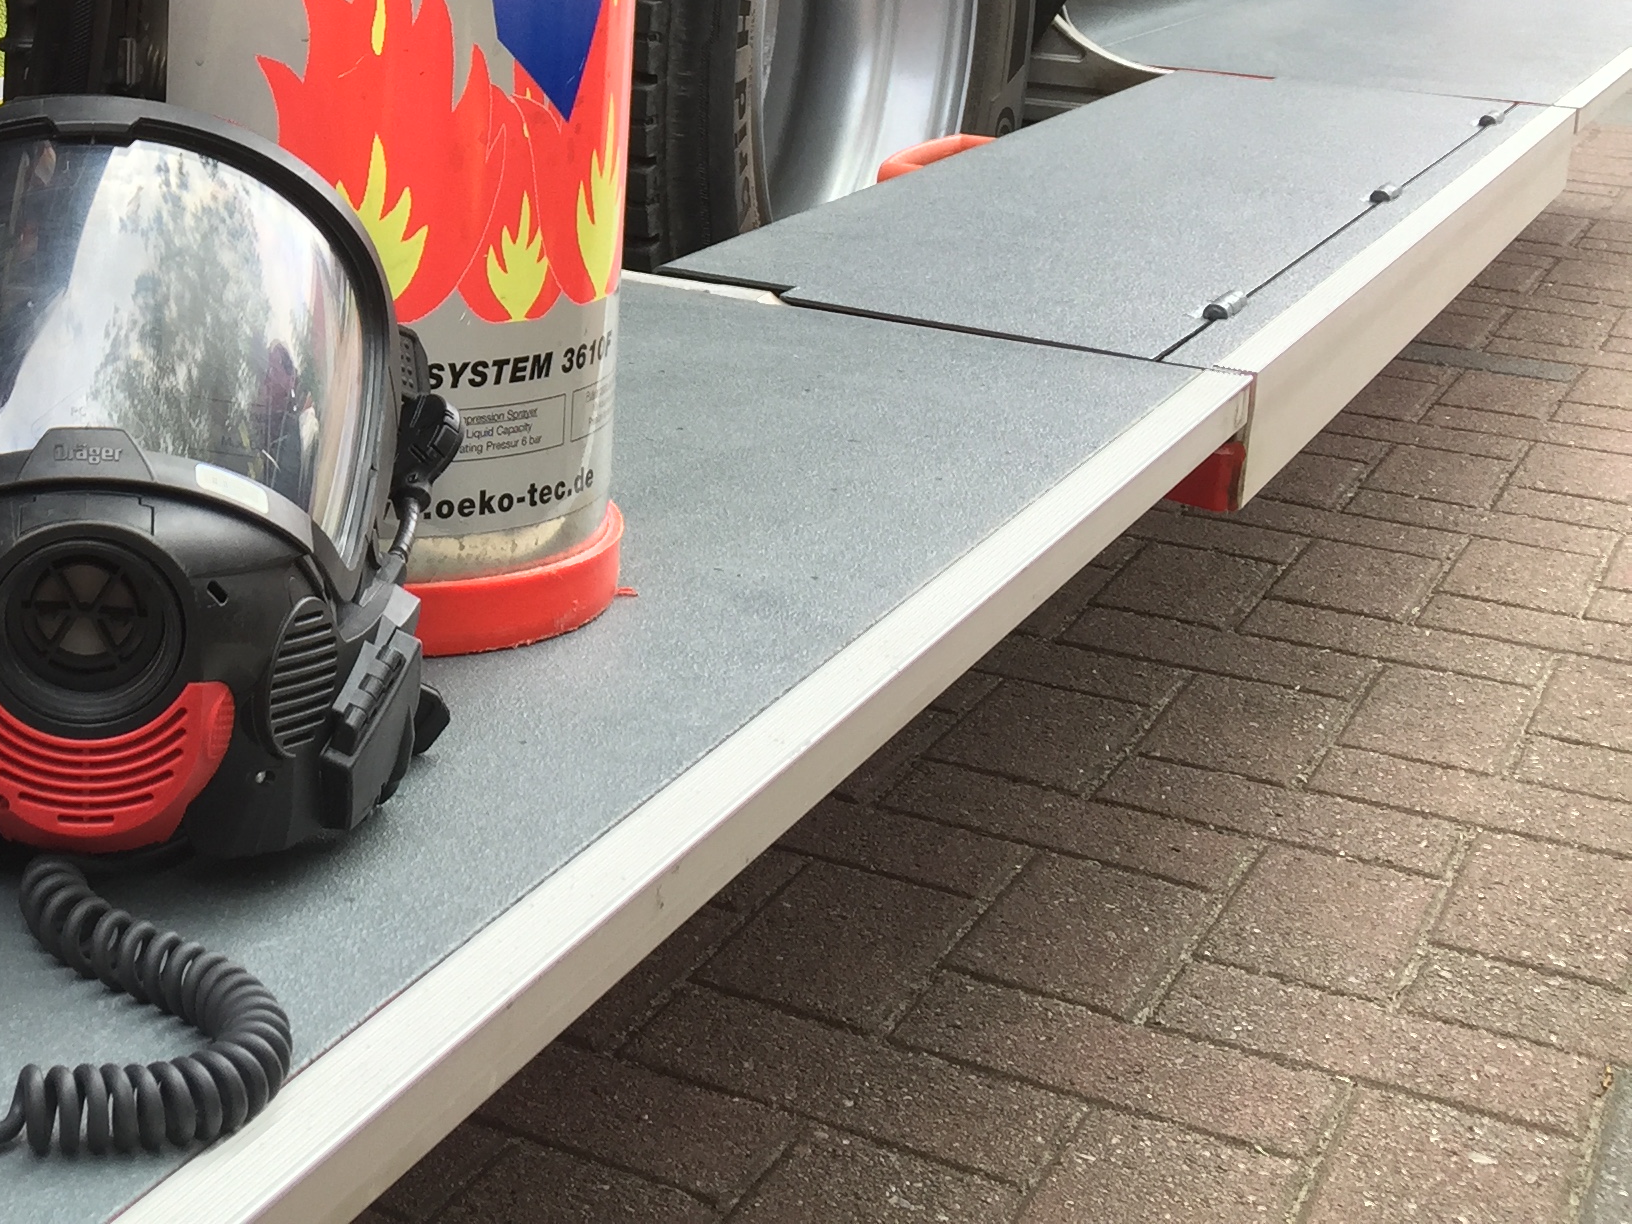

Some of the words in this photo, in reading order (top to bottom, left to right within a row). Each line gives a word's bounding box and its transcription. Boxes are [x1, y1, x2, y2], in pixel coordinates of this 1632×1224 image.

[428, 351, 555, 390] SYSTEM
[496, 422, 533, 436] Capacity
[52, 443, 124, 465] Dräger
[459, 442, 483, 455] ating
[529, 435, 542, 446] bar
[384, 467, 594, 521] .oeko-tec.de
